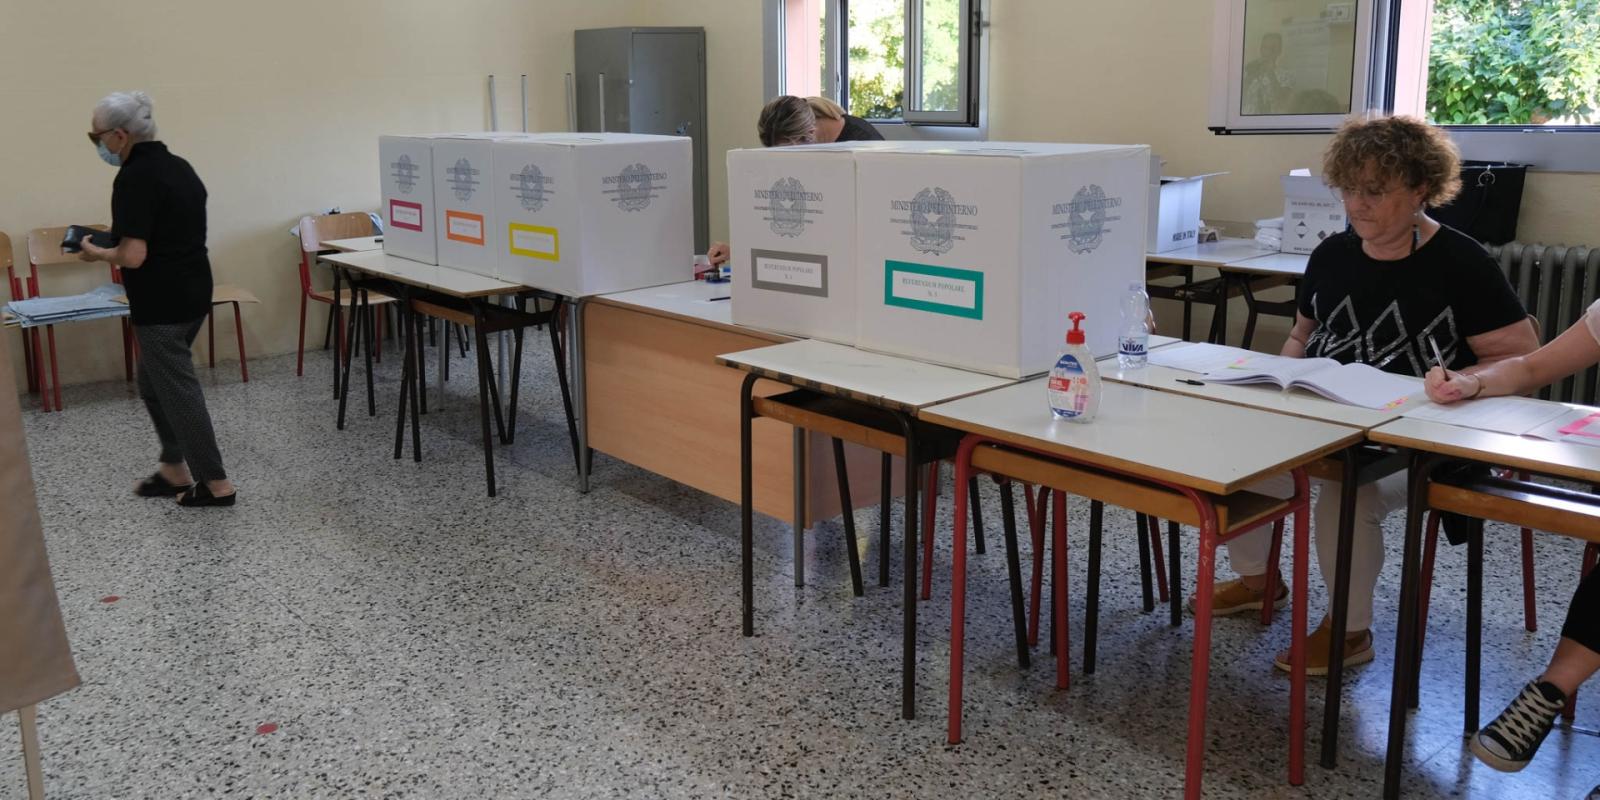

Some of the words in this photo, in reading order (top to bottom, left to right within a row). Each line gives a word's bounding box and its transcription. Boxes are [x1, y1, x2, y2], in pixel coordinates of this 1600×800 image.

[891, 200, 928, 213] MINISTERO
[902, 277, 937, 288] REFERENDUM
[938, 281, 965, 292] POPOLARE
[1122, 343, 1144, 352] VIVA
